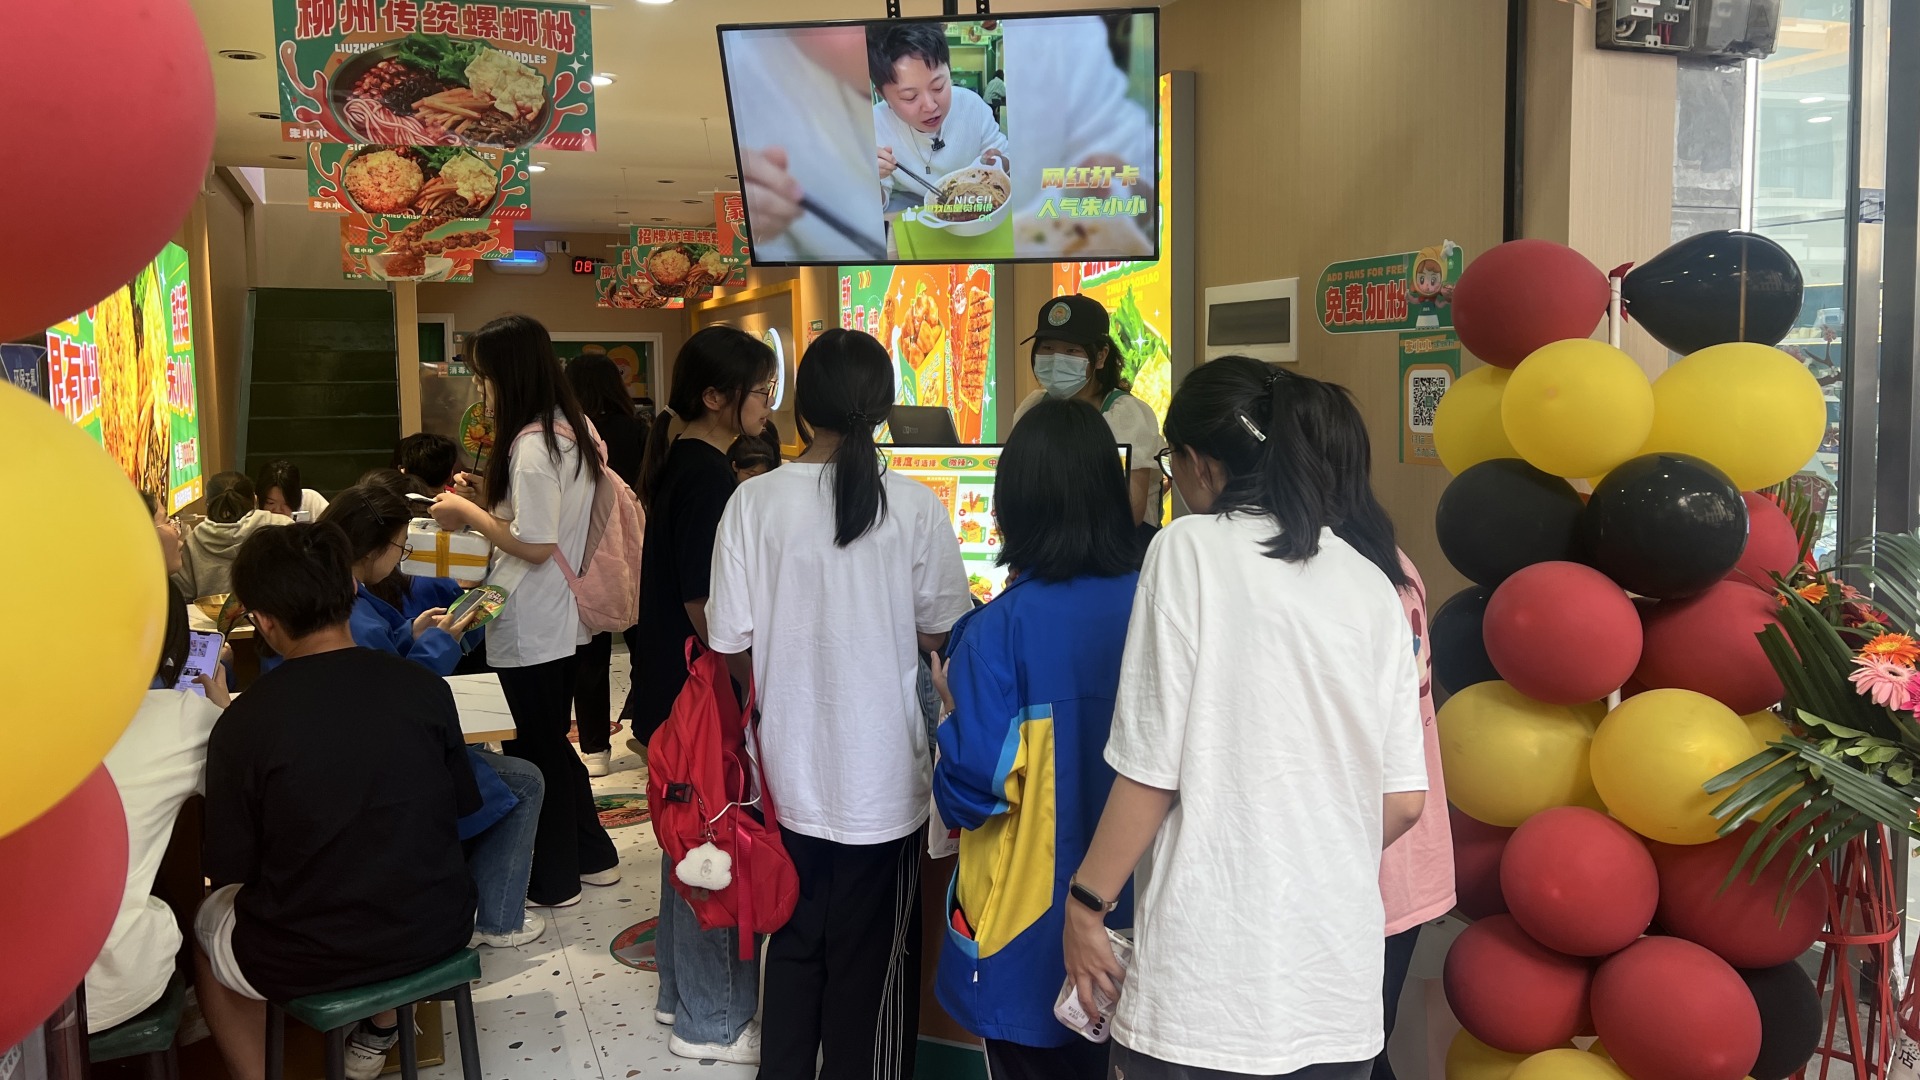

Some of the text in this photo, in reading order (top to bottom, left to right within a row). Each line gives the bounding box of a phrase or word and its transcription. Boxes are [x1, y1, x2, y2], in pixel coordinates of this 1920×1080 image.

[296, 0, 575, 54] 柳州传统螺蛳粉
[1041, 165, 1141, 189] 网红打卡
[1036, 195, 1148, 219] 人气朱小小
[574, 260, 592, 273] 08
[1327, 272, 1343, 282] ADD
[1345, 269, 1365, 280] FANS
[1367, 267, 1384, 278] FOR
[1325, 278, 1408, 326] 免费加粉
[449, 366, 470, 375] 消毒
